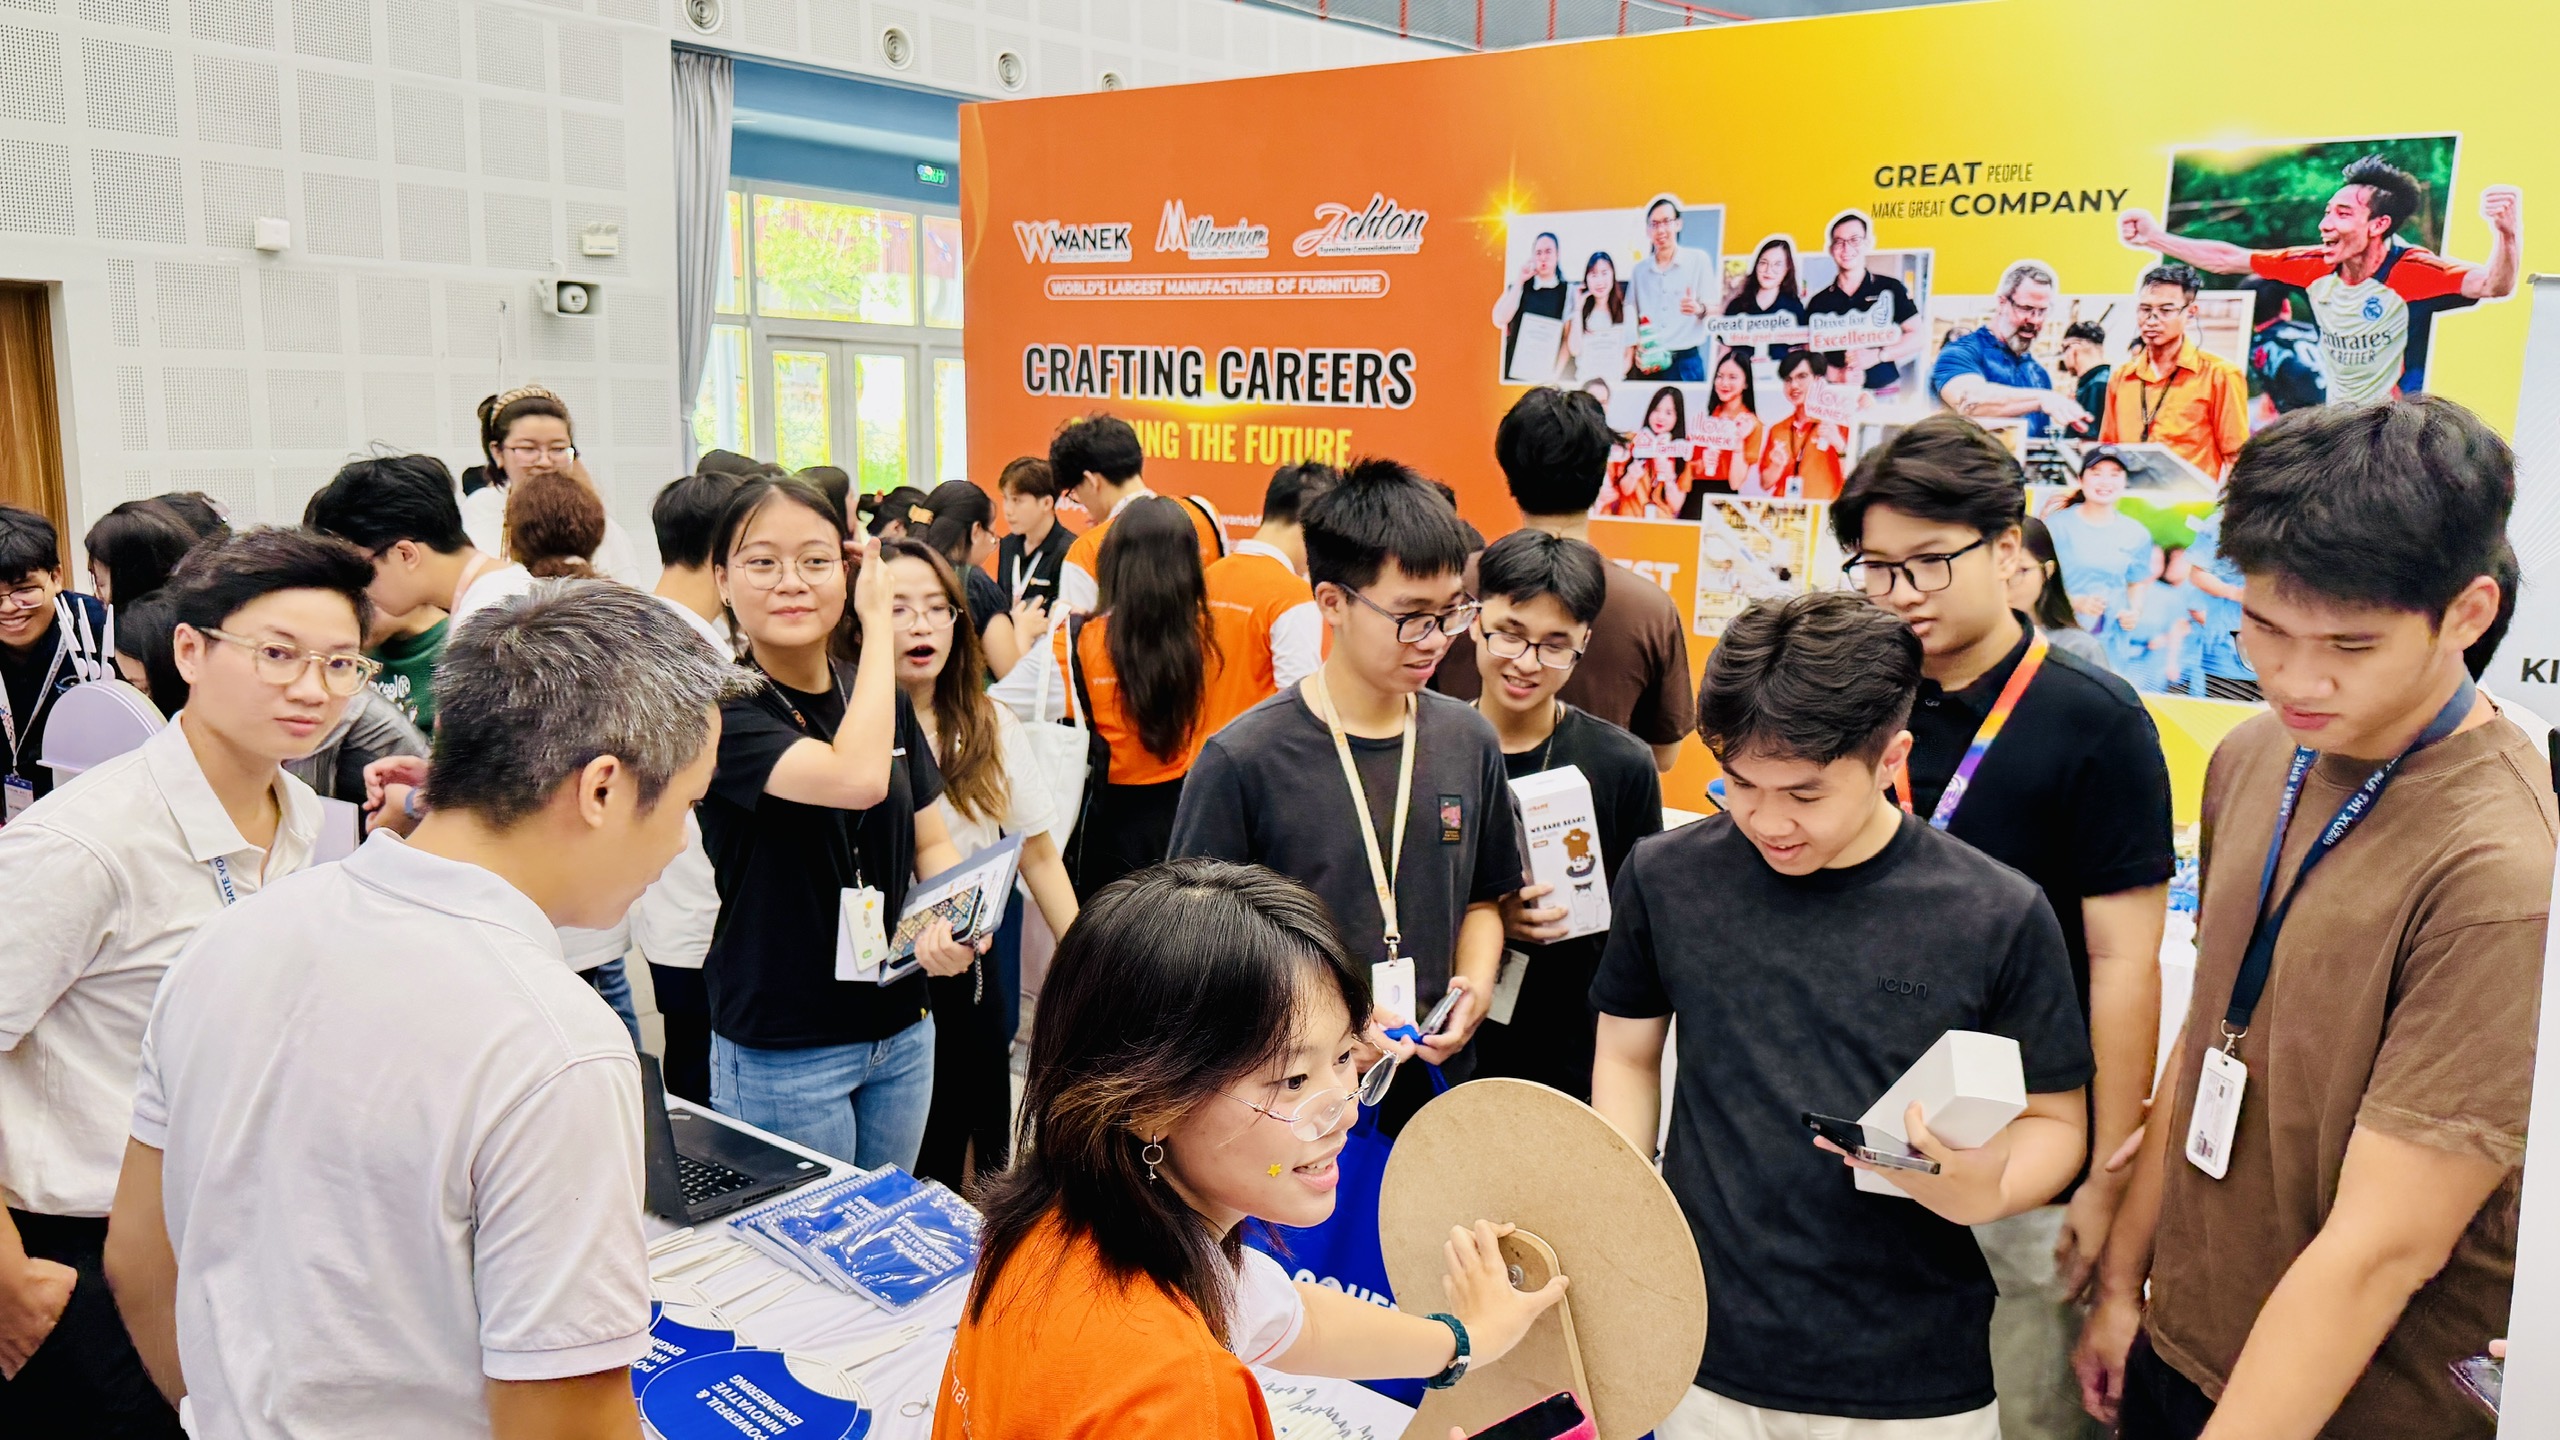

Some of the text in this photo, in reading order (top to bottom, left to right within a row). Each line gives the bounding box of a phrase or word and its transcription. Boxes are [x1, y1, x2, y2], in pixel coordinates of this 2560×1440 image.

[1874, 161, 2034, 188] GREAT PEOPLE
[1871, 188, 2129, 219] MAKE GREAT COMPANY
[1051, 275, 1381, 296] WORLD'S LARGEST MANUFACTURER OF FURNITURE
[1707, 315, 1791, 332] Great people
[1813, 328, 1895, 349] Excellence
[1024, 345, 1413, 406] CRAFTING CAREERS
[1187, 422, 1238, 463] THE
[1244, 425, 1354, 469] FUTURE
[695, 1388, 770, 1440] POWERFUL &
[711, 1381, 788, 1436] INNOVATIVE
[728, 1373, 804, 1427] ENGINEERING
